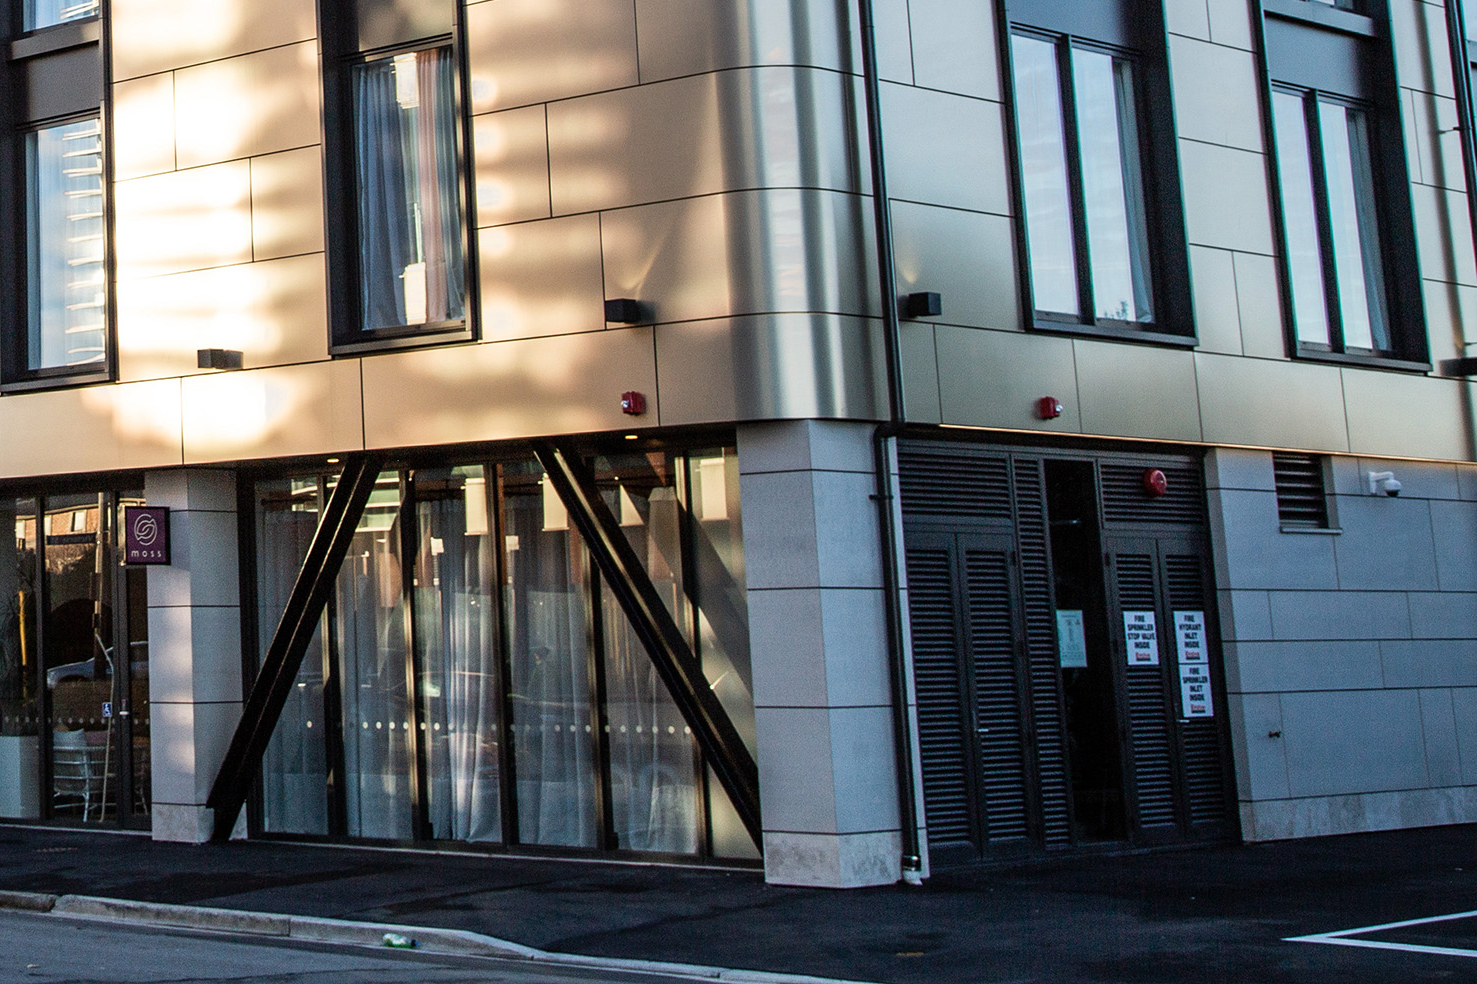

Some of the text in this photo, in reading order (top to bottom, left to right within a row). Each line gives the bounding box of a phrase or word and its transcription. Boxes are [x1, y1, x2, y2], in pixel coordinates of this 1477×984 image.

[1179, 623, 1202, 631] HYDRANT
[1127, 632, 1140, 640] STOP
[1134, 641, 1150, 649] INSIDE
[1189, 667, 1200, 675] FIRE
[1182, 676, 1208, 684] SPRINKLER
[1189, 693, 1205, 701] INSIDE
